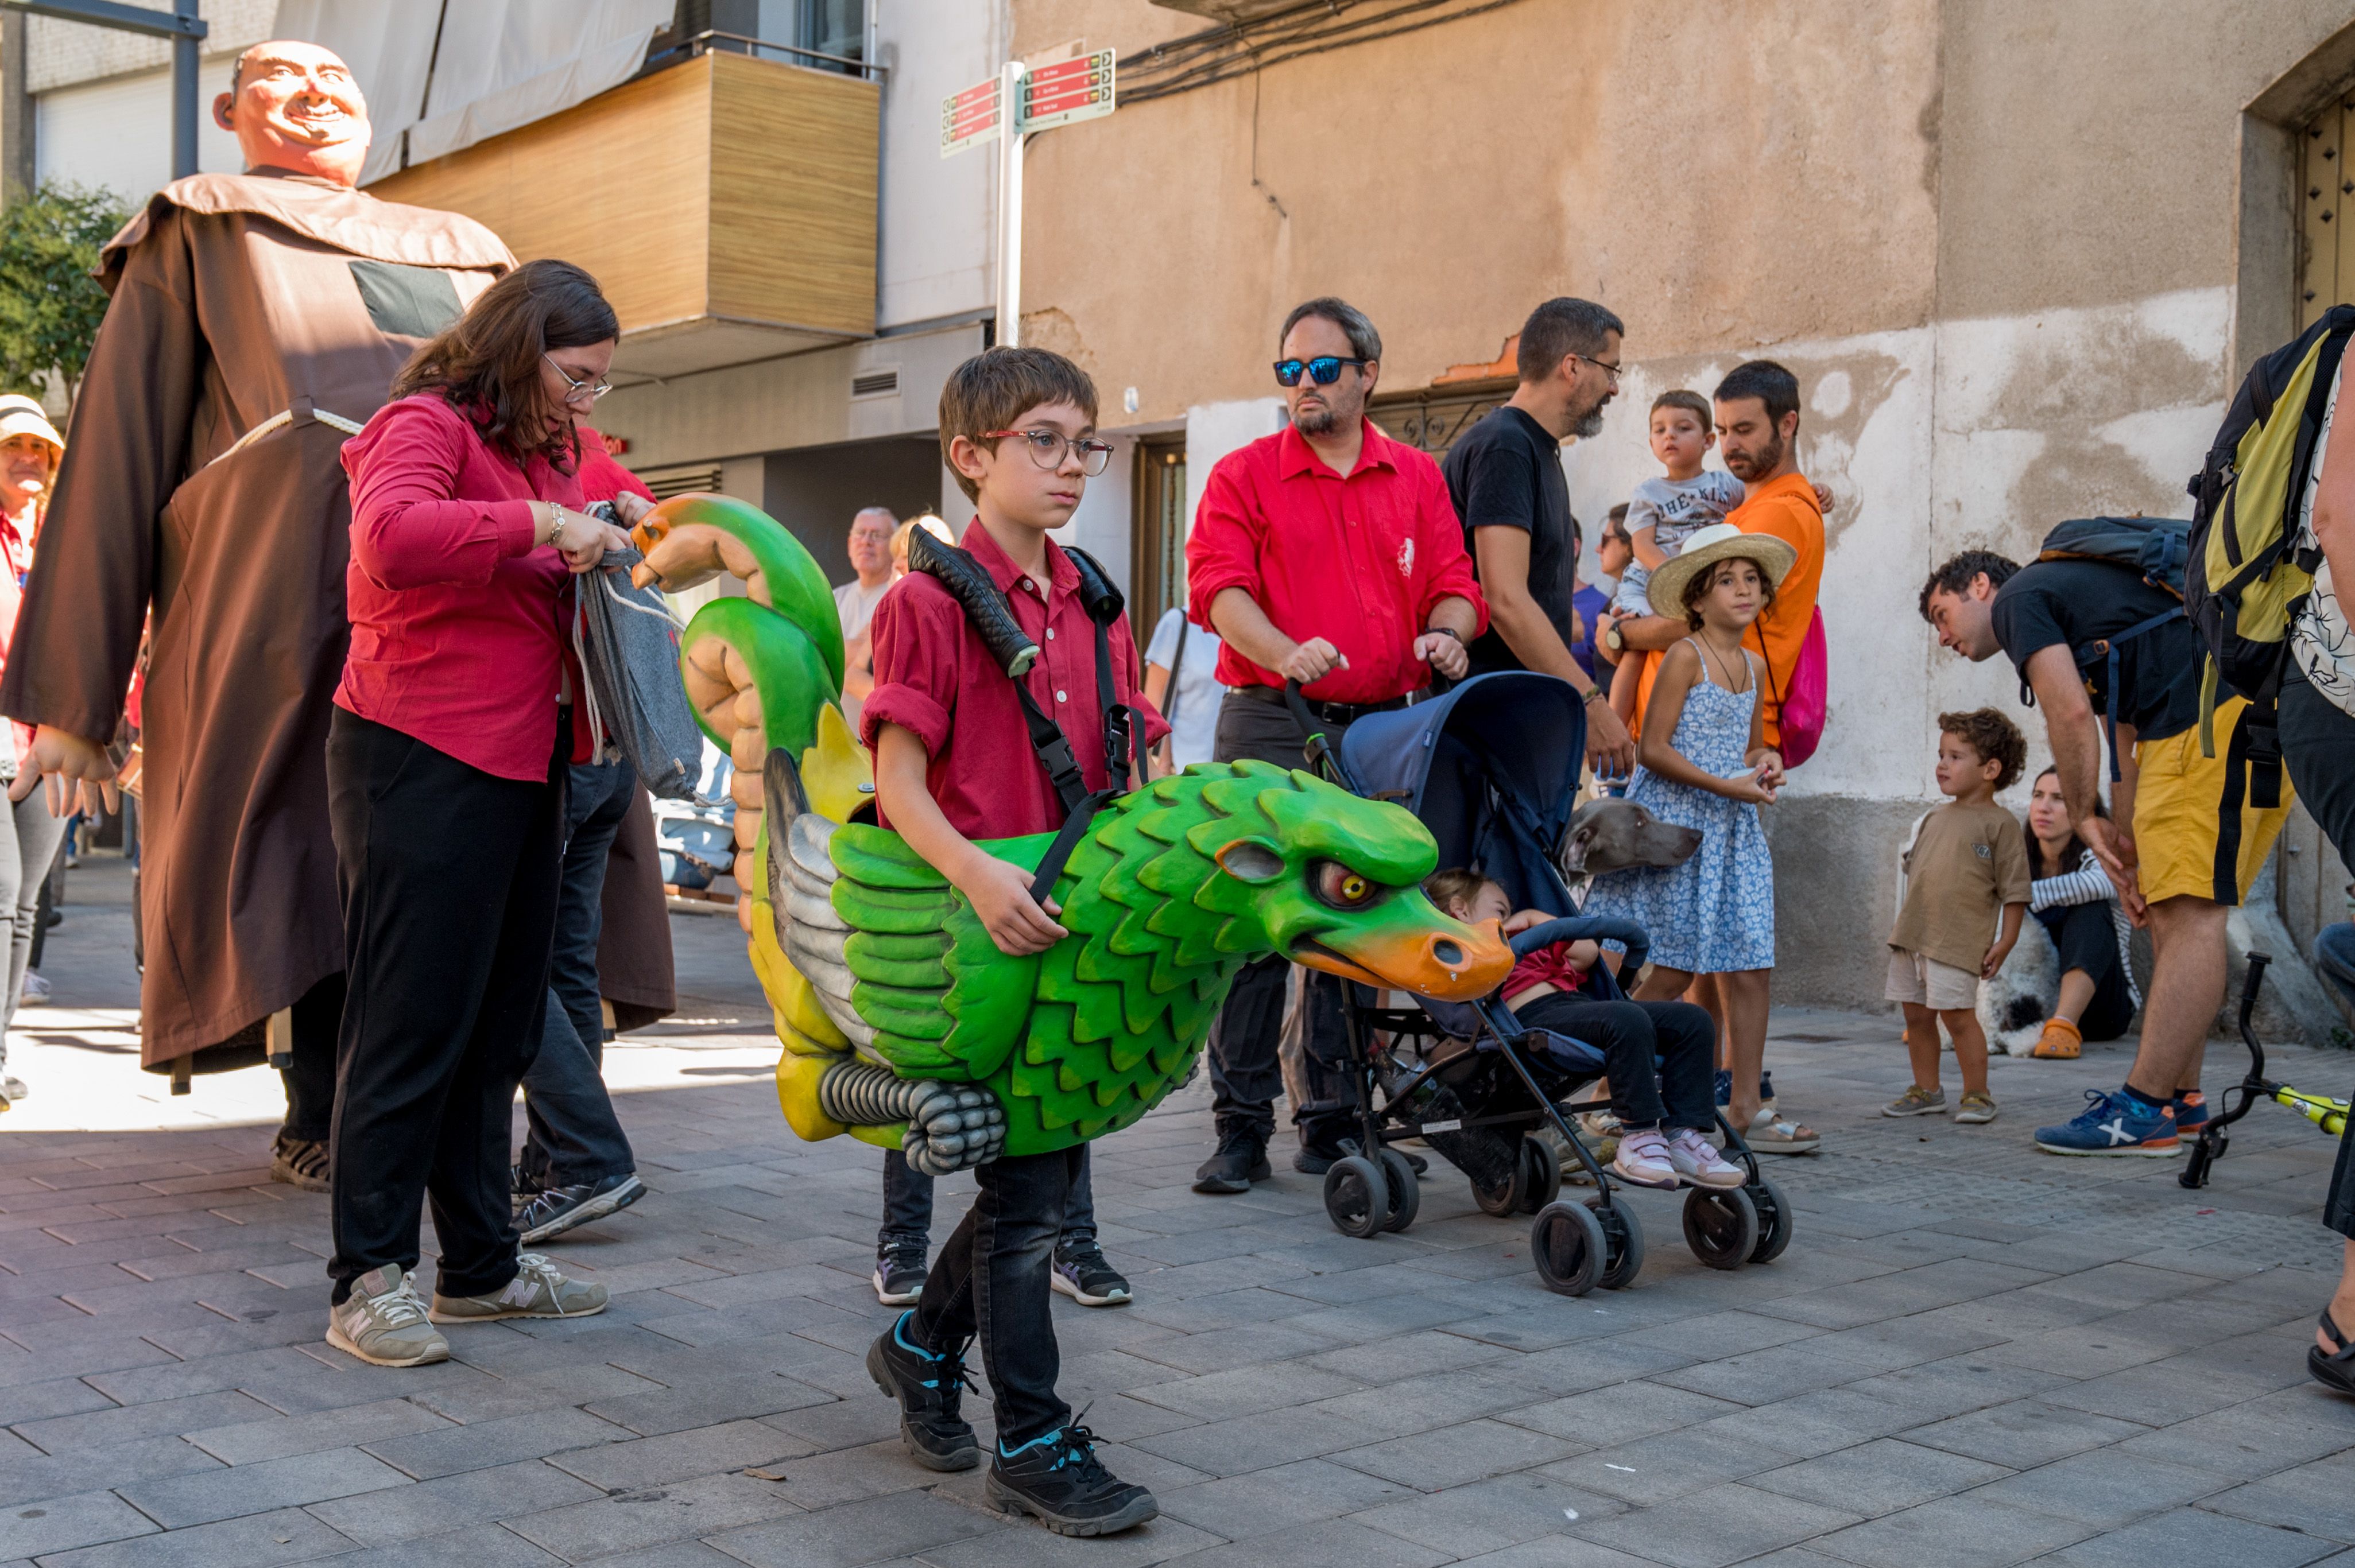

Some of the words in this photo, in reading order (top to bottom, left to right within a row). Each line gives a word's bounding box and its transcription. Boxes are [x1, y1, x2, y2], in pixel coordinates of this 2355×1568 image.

[1657, 492, 1690, 518] THE
[499, 1278, 541, 1309] N
[344, 1307, 372, 1341] N
